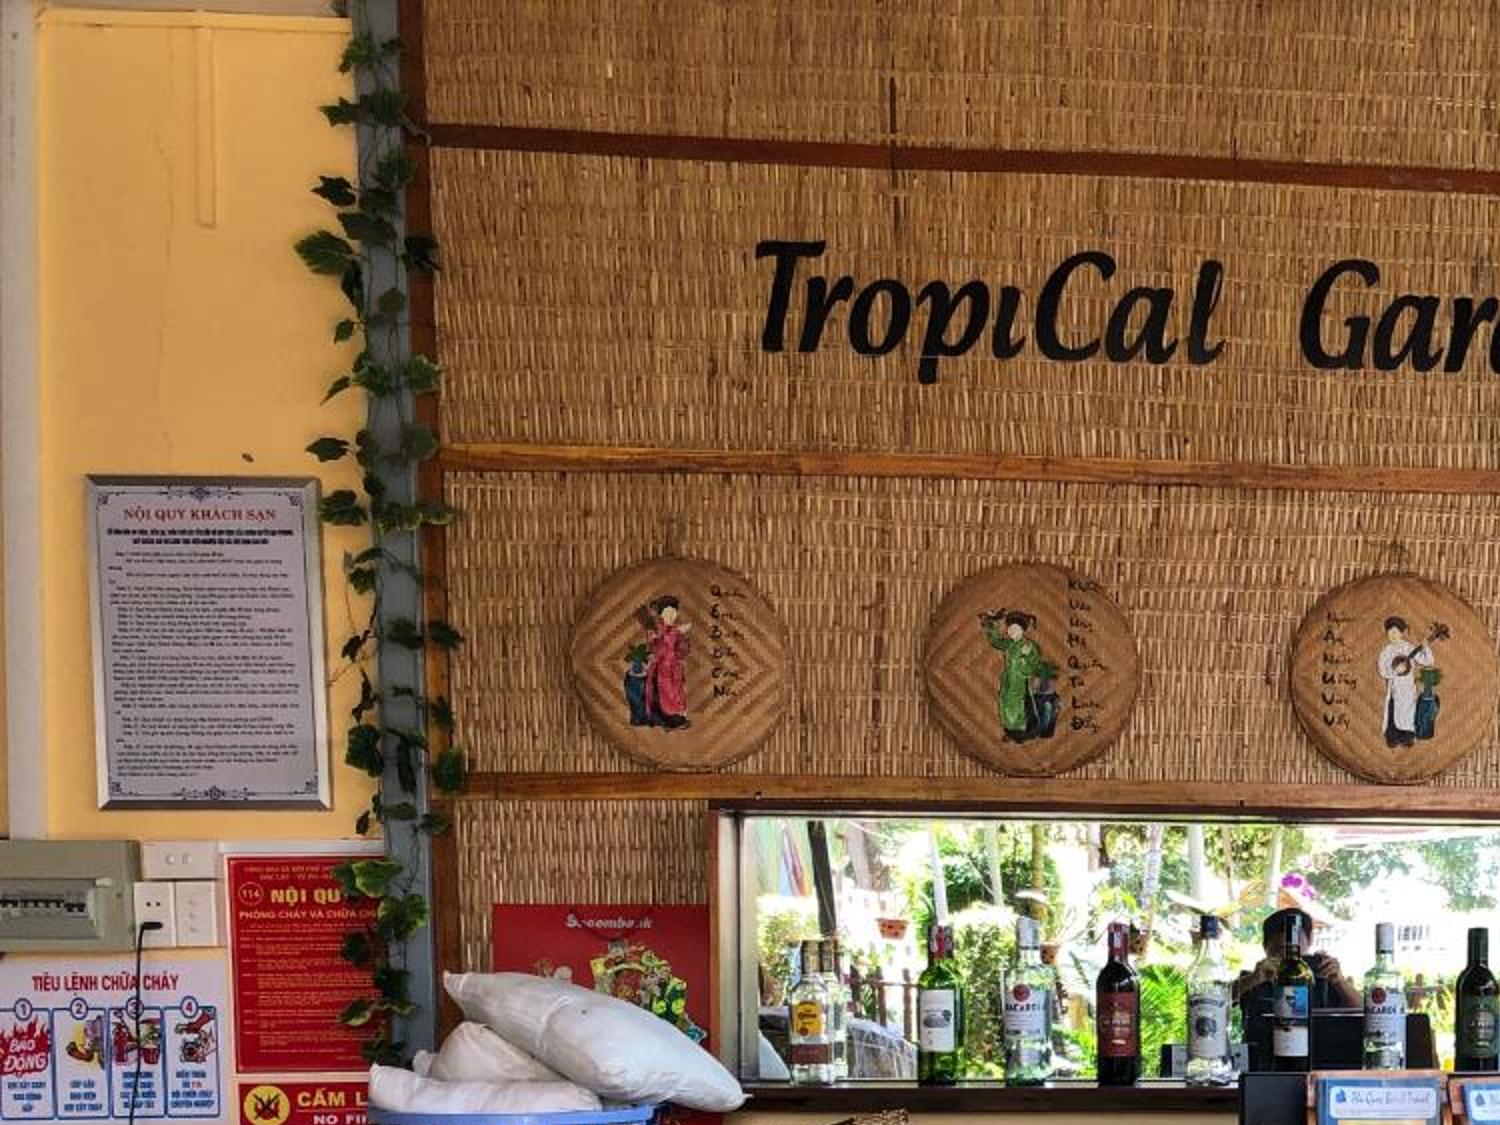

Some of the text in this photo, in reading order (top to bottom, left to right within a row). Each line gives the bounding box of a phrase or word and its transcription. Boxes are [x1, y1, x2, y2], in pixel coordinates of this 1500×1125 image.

[755, 240, 1226, 385] TropiCal
[155, 508, 189, 522] QUY
[270, 886, 341, 907] NỘI QU
[143, 971, 180, 990] CHÁY
[75, 1003, 84, 1015] 2
[185, 1001, 194, 1013] 4
[3, 1053, 47, 1076] ĐỘNG
[297, 1087, 346, 1107] CẤM
[313, 1115, 339, 1125] NO
